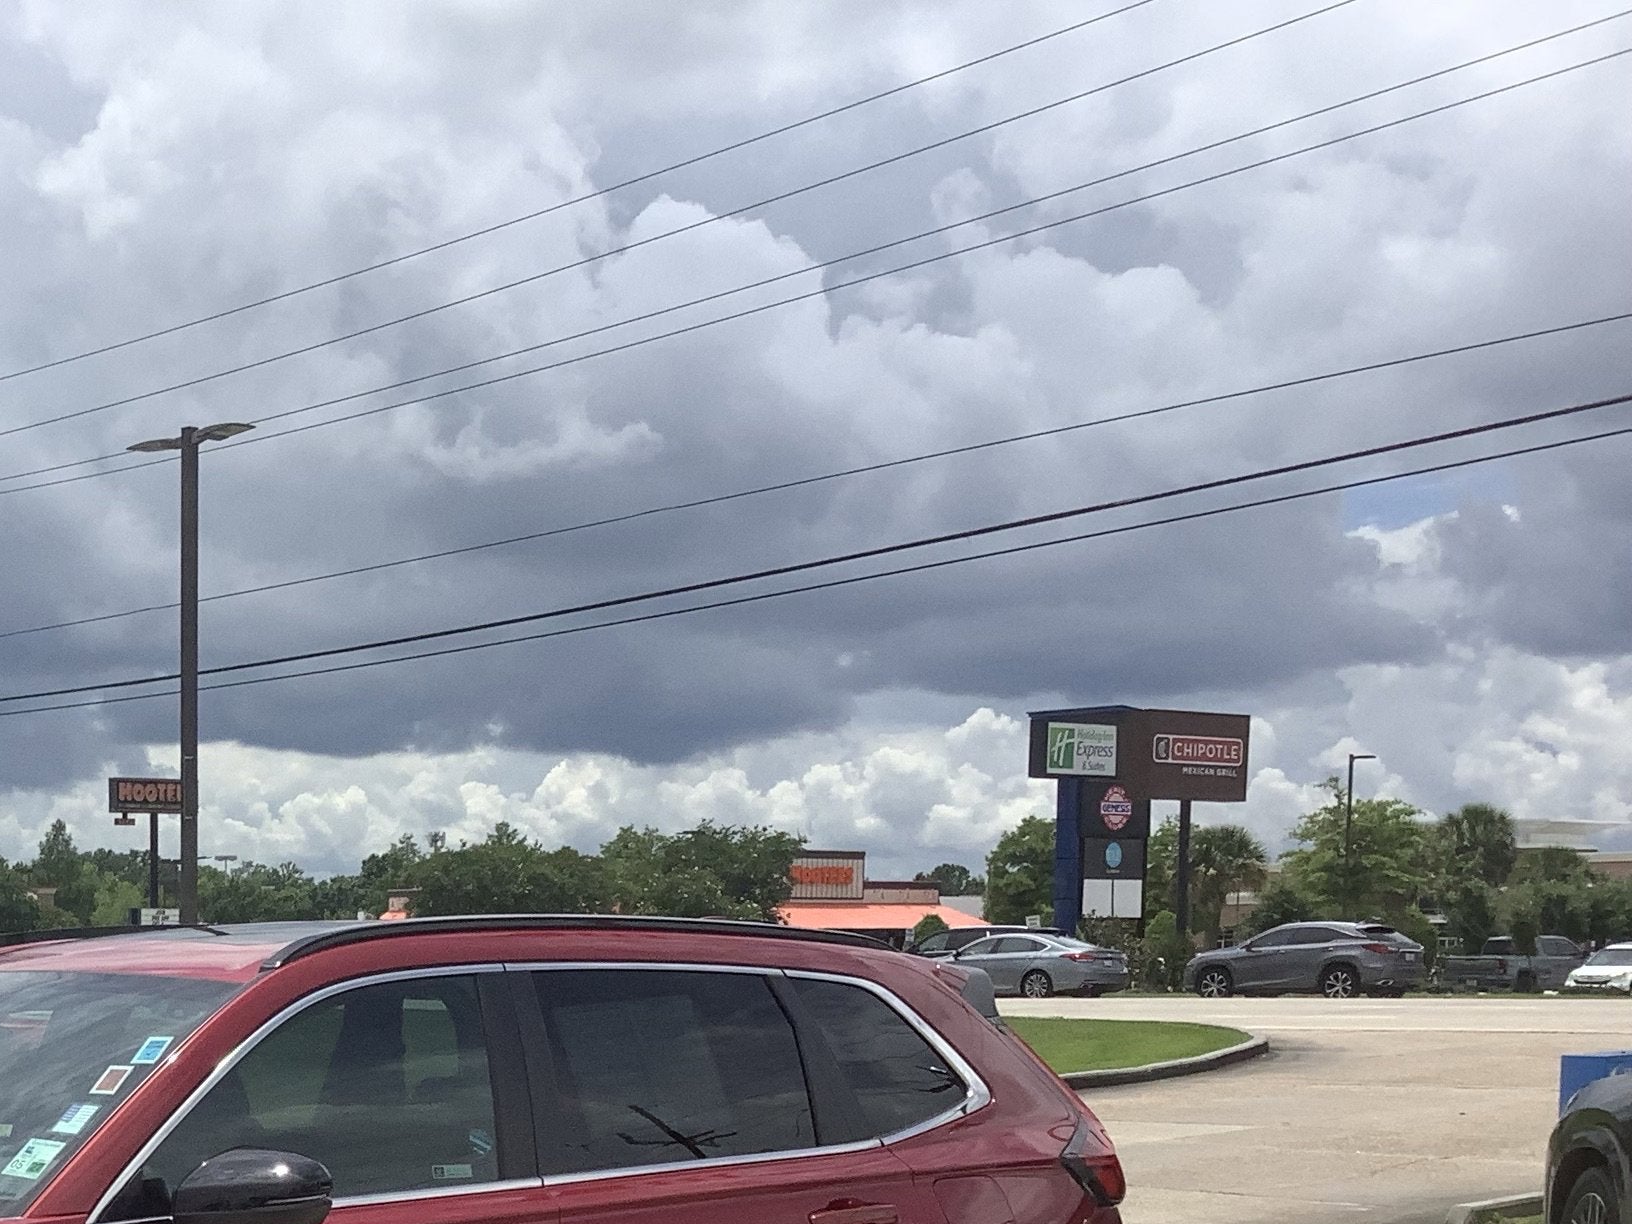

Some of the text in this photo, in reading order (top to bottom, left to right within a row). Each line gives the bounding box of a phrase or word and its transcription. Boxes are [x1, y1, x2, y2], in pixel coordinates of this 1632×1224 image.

[1076, 741, 1113, 759] Express
[1174, 742, 1239, 760] CHIPOTLE
[1182, 766, 1237, 778] MEXICAN GRILL
